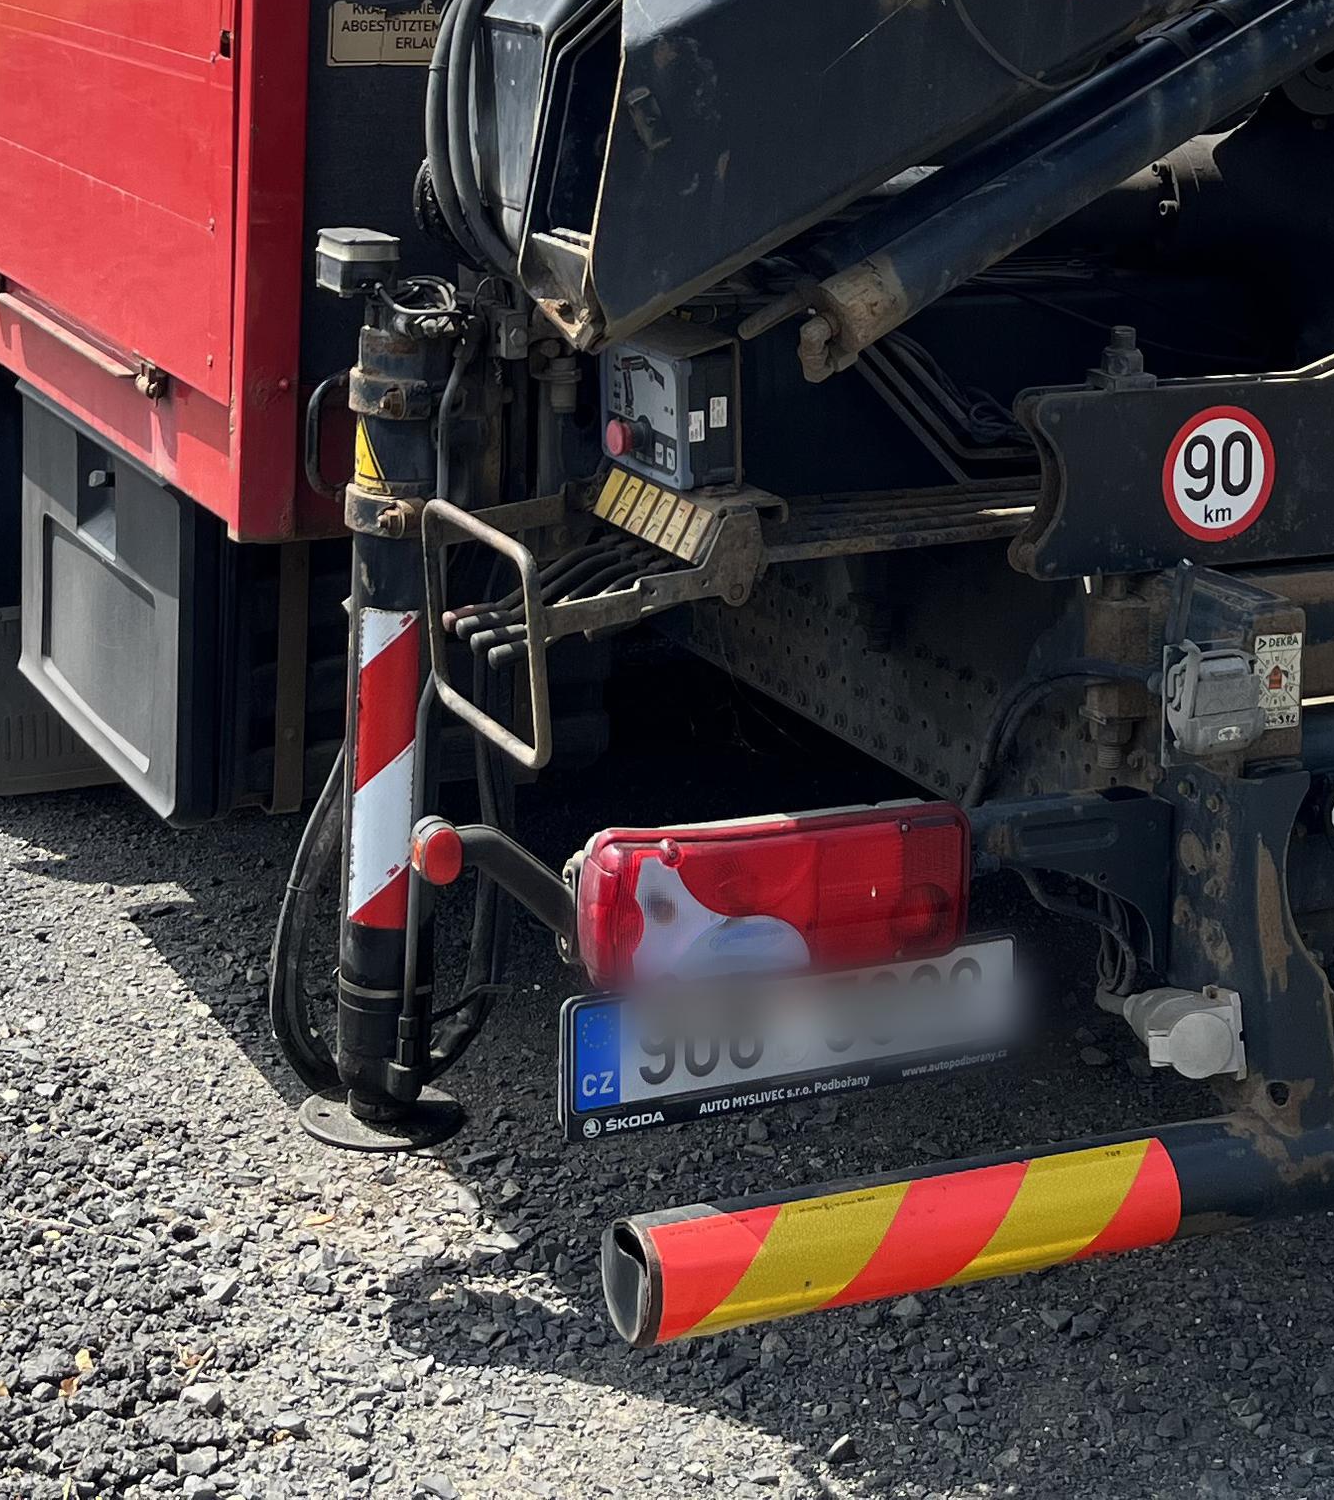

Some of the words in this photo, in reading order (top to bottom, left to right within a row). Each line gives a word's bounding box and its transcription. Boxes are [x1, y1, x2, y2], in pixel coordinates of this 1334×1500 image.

[1183, 430, 1253, 502] 90
[1203, 504, 1232, 524] km
[1268, 635, 1299, 648] DEKRA
[581, 1071, 614, 1097] CZ
[699, 1098, 730, 1115] AUTO
[732, 1088, 785, 1109] MYSLIVEC
[786, 1086, 812, 1098] s.r.o.
[814, 1074, 871, 1094] Podbořany
[605, 1111, 665, 1132] ŠKODA
